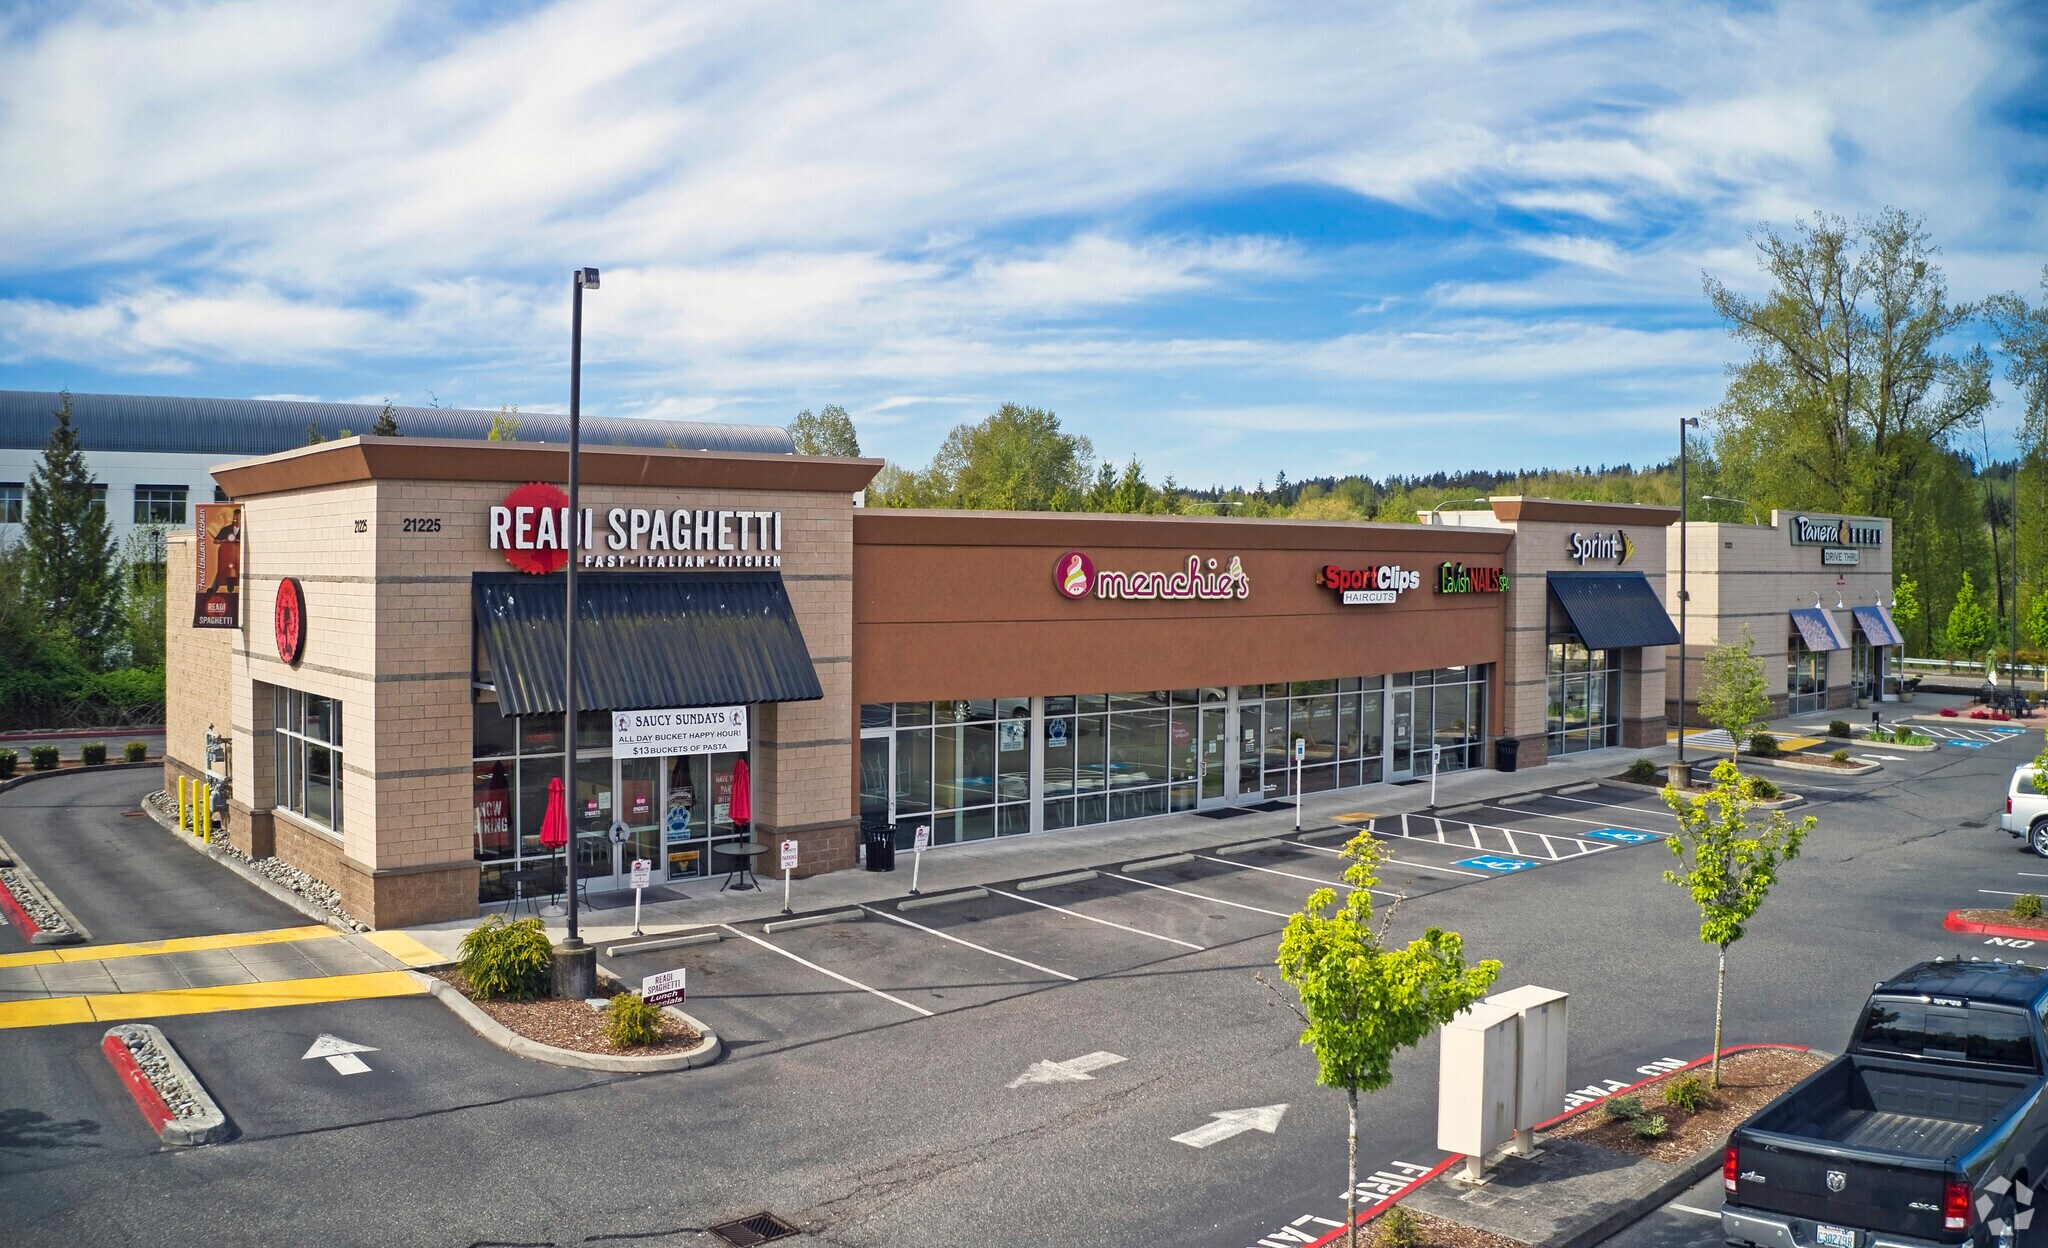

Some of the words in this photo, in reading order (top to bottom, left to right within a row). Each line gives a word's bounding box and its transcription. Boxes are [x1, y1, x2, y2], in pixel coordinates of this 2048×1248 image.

[197, 508, 206, 541] Kitchen
[354, 519, 368, 534] 21225
[403, 518, 442, 533] 21225
[489, 506, 593, 550] READI
[607, 507, 782, 551] SPAGHETTI
[1796, 516, 1838, 542] Panera
[1851, 528, 1883, 544] BREAD
[197, 541, 206, 569] Italian
[1573, 532, 1618, 566] Sprint
[584, 555, 626, 568] FAST
[639, 555, 705, 568] ITALIAN
[718, 555, 781, 568] KITCHEN
[1825, 552, 1843, 562] DRIVE
[1844, 552, 1859, 562] THRU
[197, 570, 206, 592] Fast
[1097, 554, 1250, 600] menchie's
[1442, 562, 1471, 593] Lavish
[1471, 567, 1499, 593] NAILS
[1345, 593, 1395, 602] HAIRCUTS
[207, 602, 226, 611] READI
[199, 616, 232, 625] SPAGHETTI
[635, 715, 672, 727] SAUCY
[675, 712, 726, 725] SUNDAYS
[655, 733, 687, 741] BUCKET
[716, 730, 741, 738] HOUR!
[632, 746, 651, 756] $13
[650, 745, 688, 754] BUCKETS
[702, 743, 728, 751] PASTA
[720, 785, 732, 794] PAR
[480, 801, 502, 817] NOW
[1984, 937, 2035, 949] NO
[655, 973, 674, 984] READI
[647, 980, 681, 995] SPAGHETTI
[650, 990, 679, 1003] Lunch
